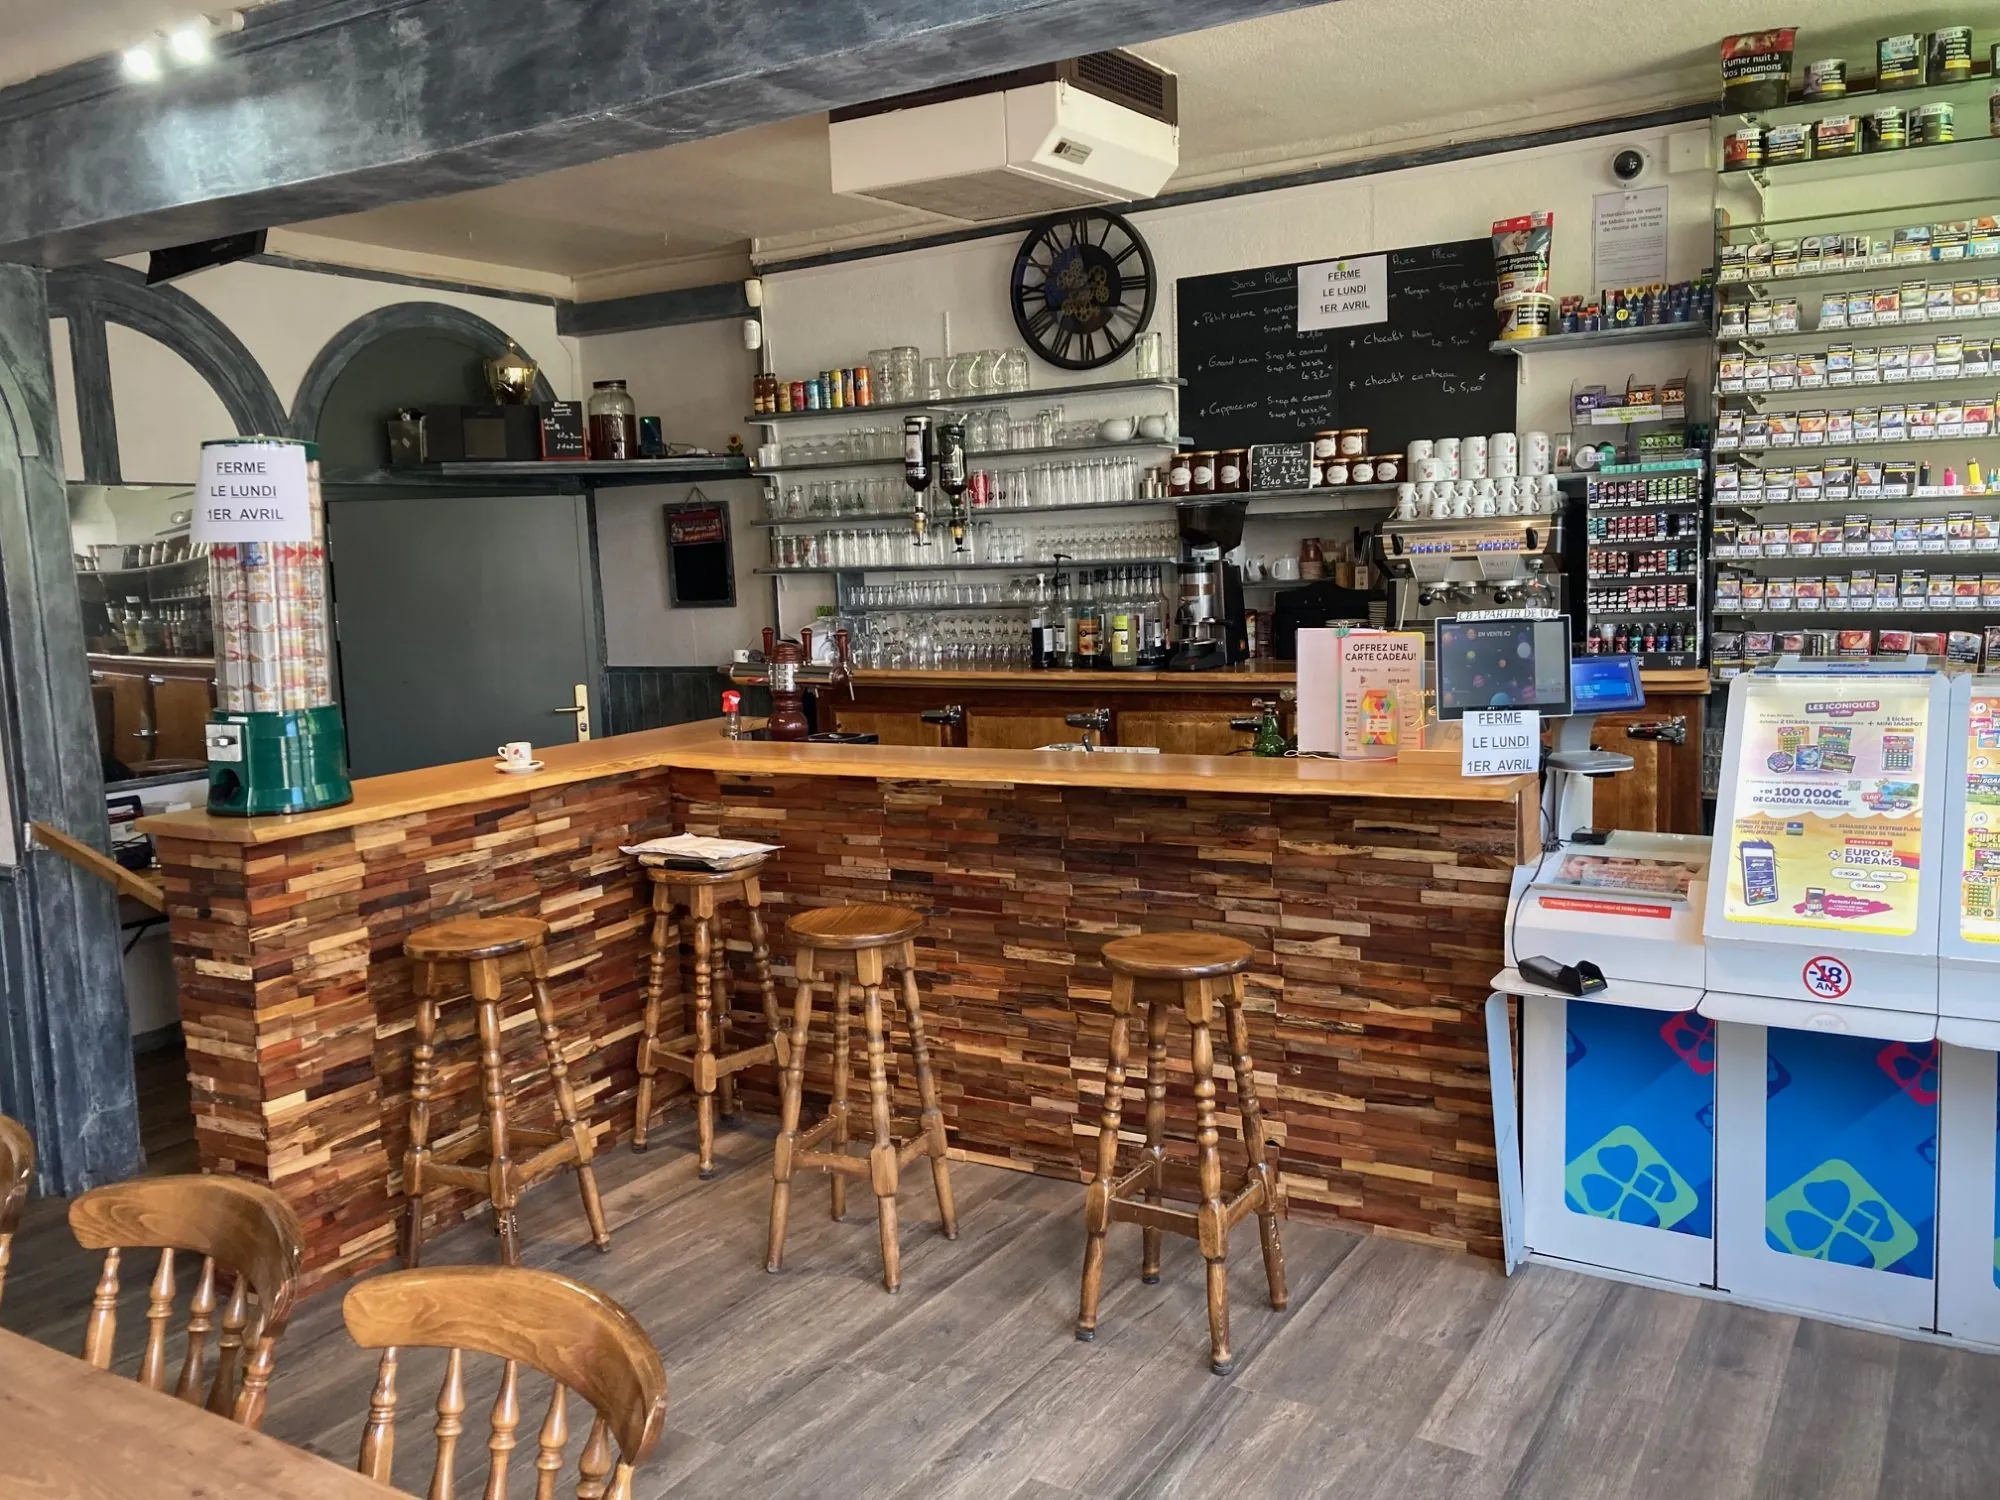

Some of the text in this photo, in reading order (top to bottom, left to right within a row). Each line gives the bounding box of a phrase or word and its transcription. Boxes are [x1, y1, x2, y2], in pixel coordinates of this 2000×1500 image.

[1722, 56, 1750, 68] Fumer
[1752, 53, 1771, 63] nuit
[1723, 63, 1782, 78] vos poumons
[1328, 269, 1360, 280] FERME
[1323, 285, 1366, 296] LE LUNDI
[1320, 301, 1370, 312] 1ER AVRIL
[217, 462, 266, 473] FERME
[211, 486, 276, 497] LE LUNDI
[208, 509, 283, 519] 1ER AVRIL
[1485, 610, 1521, 619] PARTIR
[1524, 609, 1537, 618] DE
[1353, 643, 1408, 651] OFFREZ UNE
[1808, 701, 1877, 711] LES ICONIQUES
[1479, 712, 1522, 724] FERME
[1473, 736, 1529, 748] LE LUNDI
[1467, 759, 1532, 771] 1ER AVRIL
[1774, 787, 1801, 796] 100
[1762, 796, 1804, 804] CADEAUX
[1845, 848, 1880, 857] EURO
[1844, 856, 1900, 866] DREAMS
[1809, 965, 1842, 984] -18
